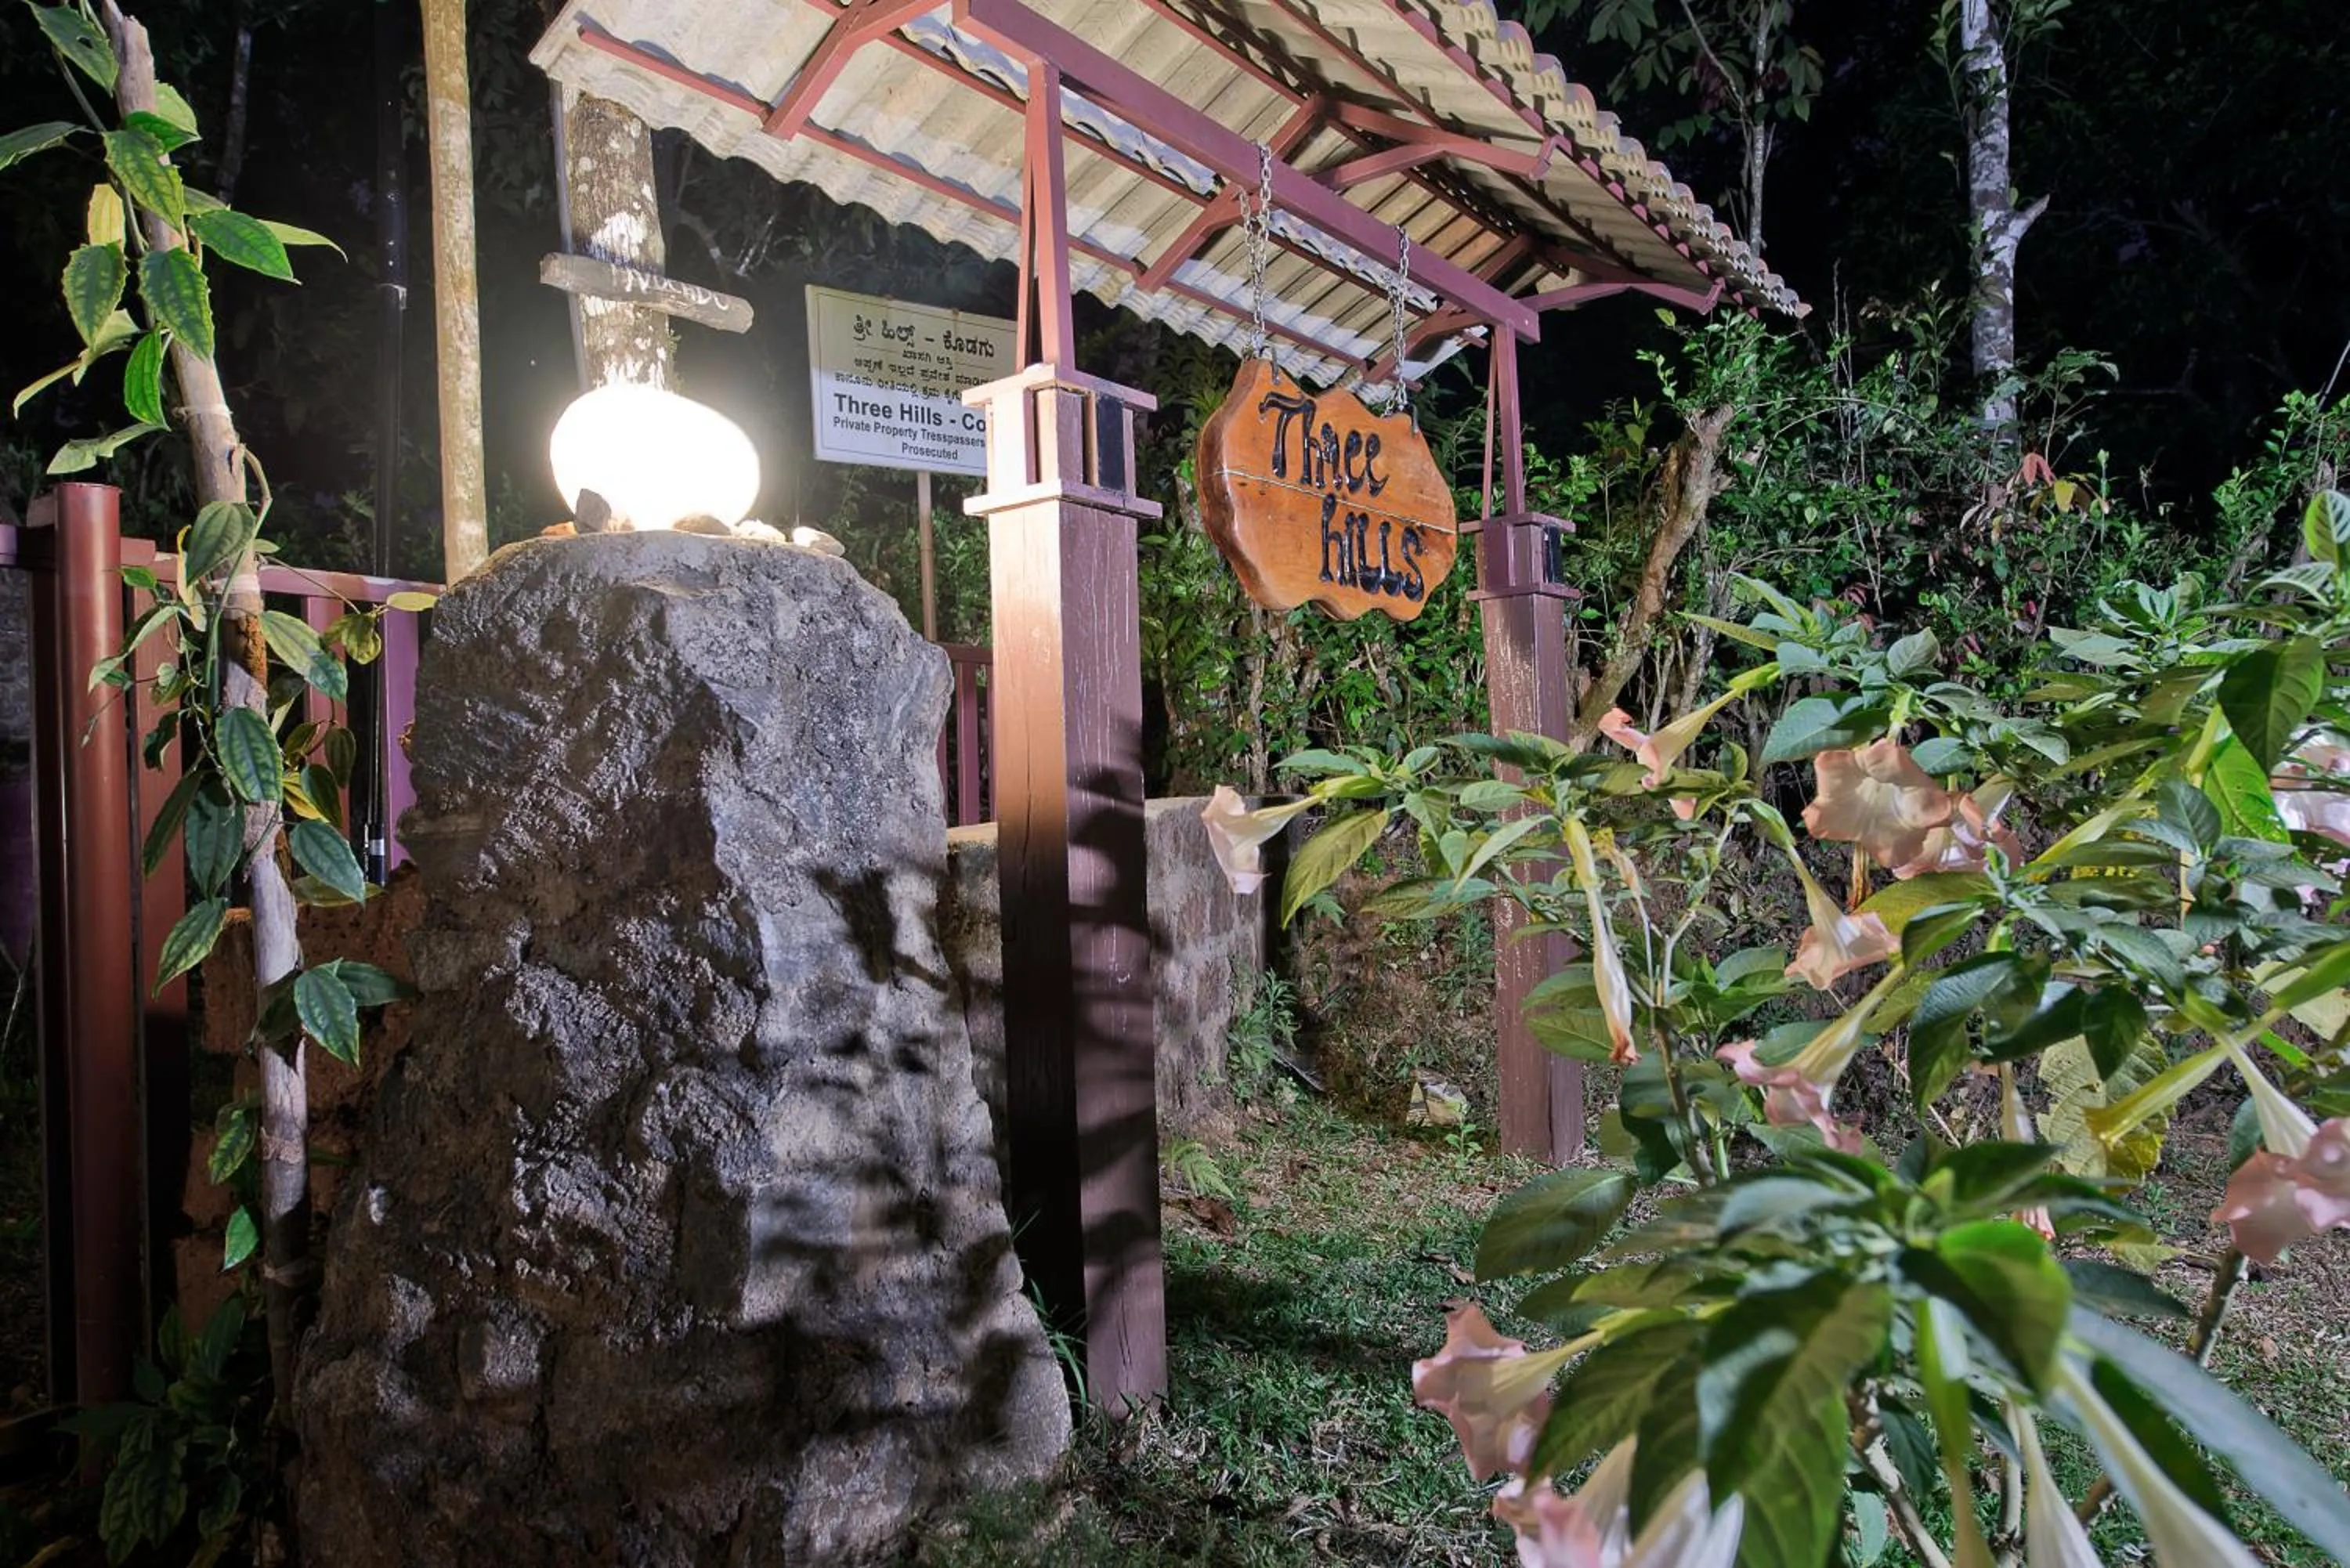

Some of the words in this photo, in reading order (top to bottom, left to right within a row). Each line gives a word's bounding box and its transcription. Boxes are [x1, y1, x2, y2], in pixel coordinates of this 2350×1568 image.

[833, 393, 893, 419] Three
[900, 403, 943, 427] Hills
[833, 416, 871, 432] Private
[873, 422, 918, 440] Property
[921, 428, 985, 448] Tresspassers
[902, 442, 959, 461] Prosecuted
